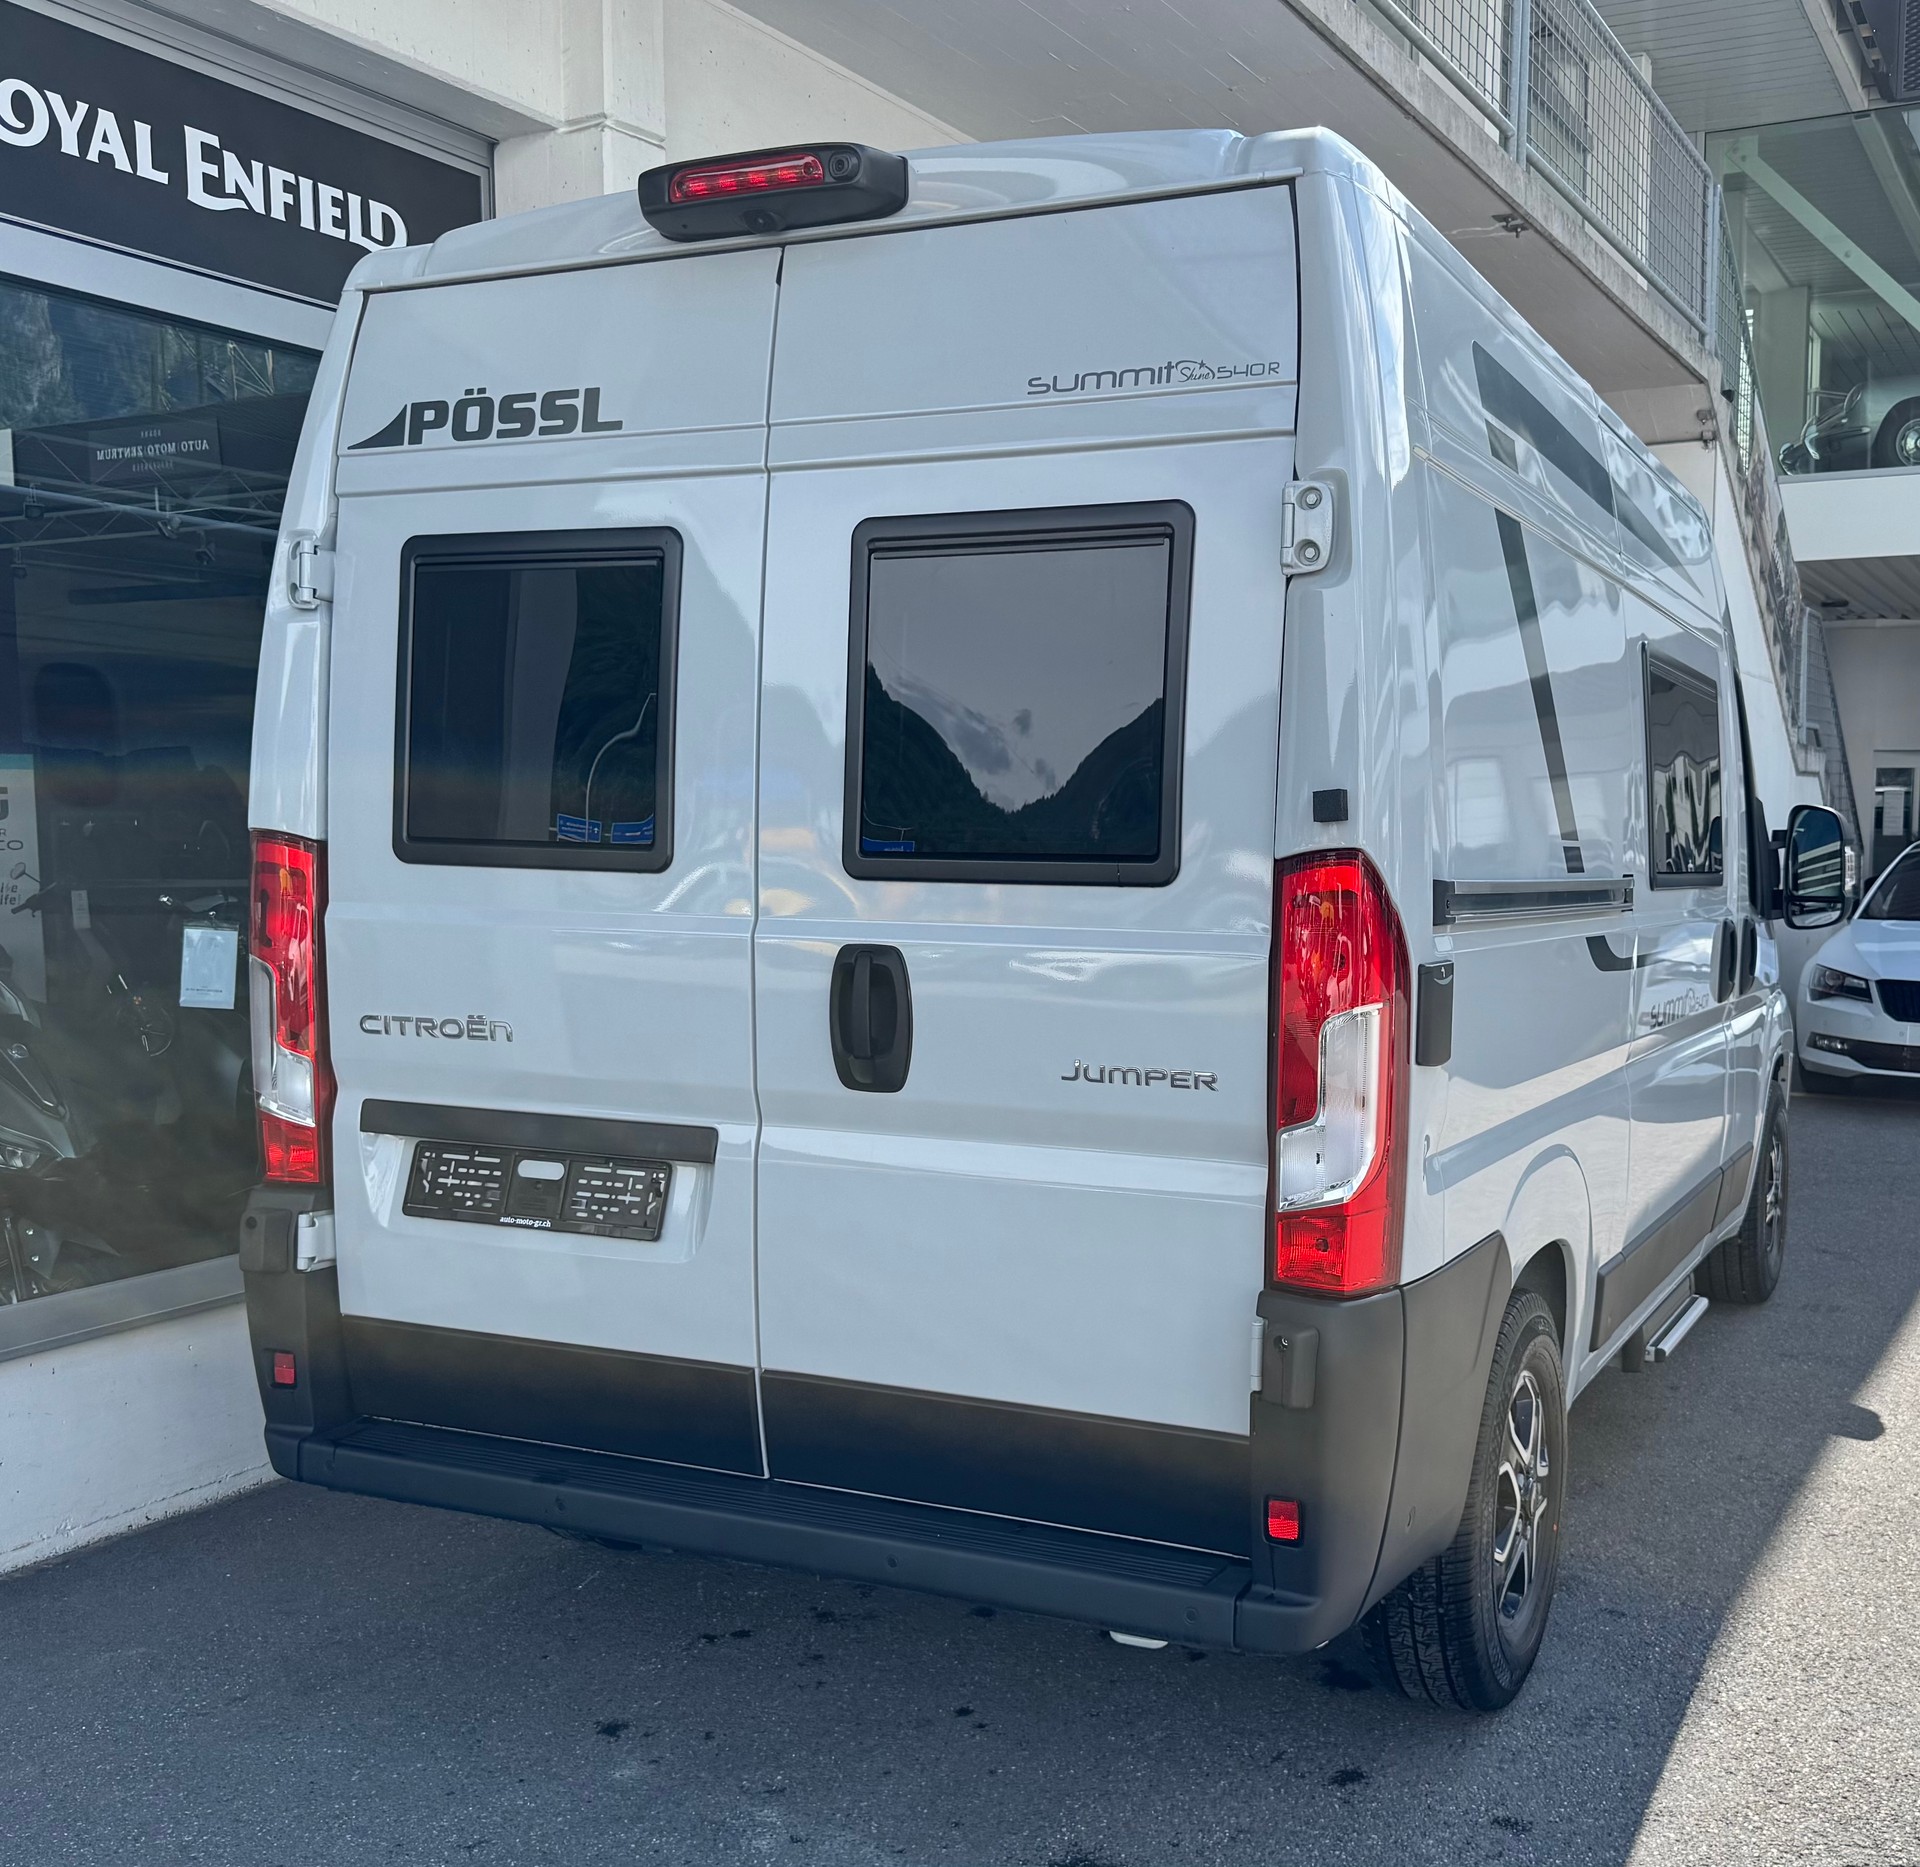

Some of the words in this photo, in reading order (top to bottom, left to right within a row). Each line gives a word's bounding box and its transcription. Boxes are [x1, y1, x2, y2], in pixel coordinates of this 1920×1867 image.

[184, 125, 408, 253] ENFIELD
[1027, 361, 1175, 395] summit
[408, 387, 623, 446] PÖSSL
